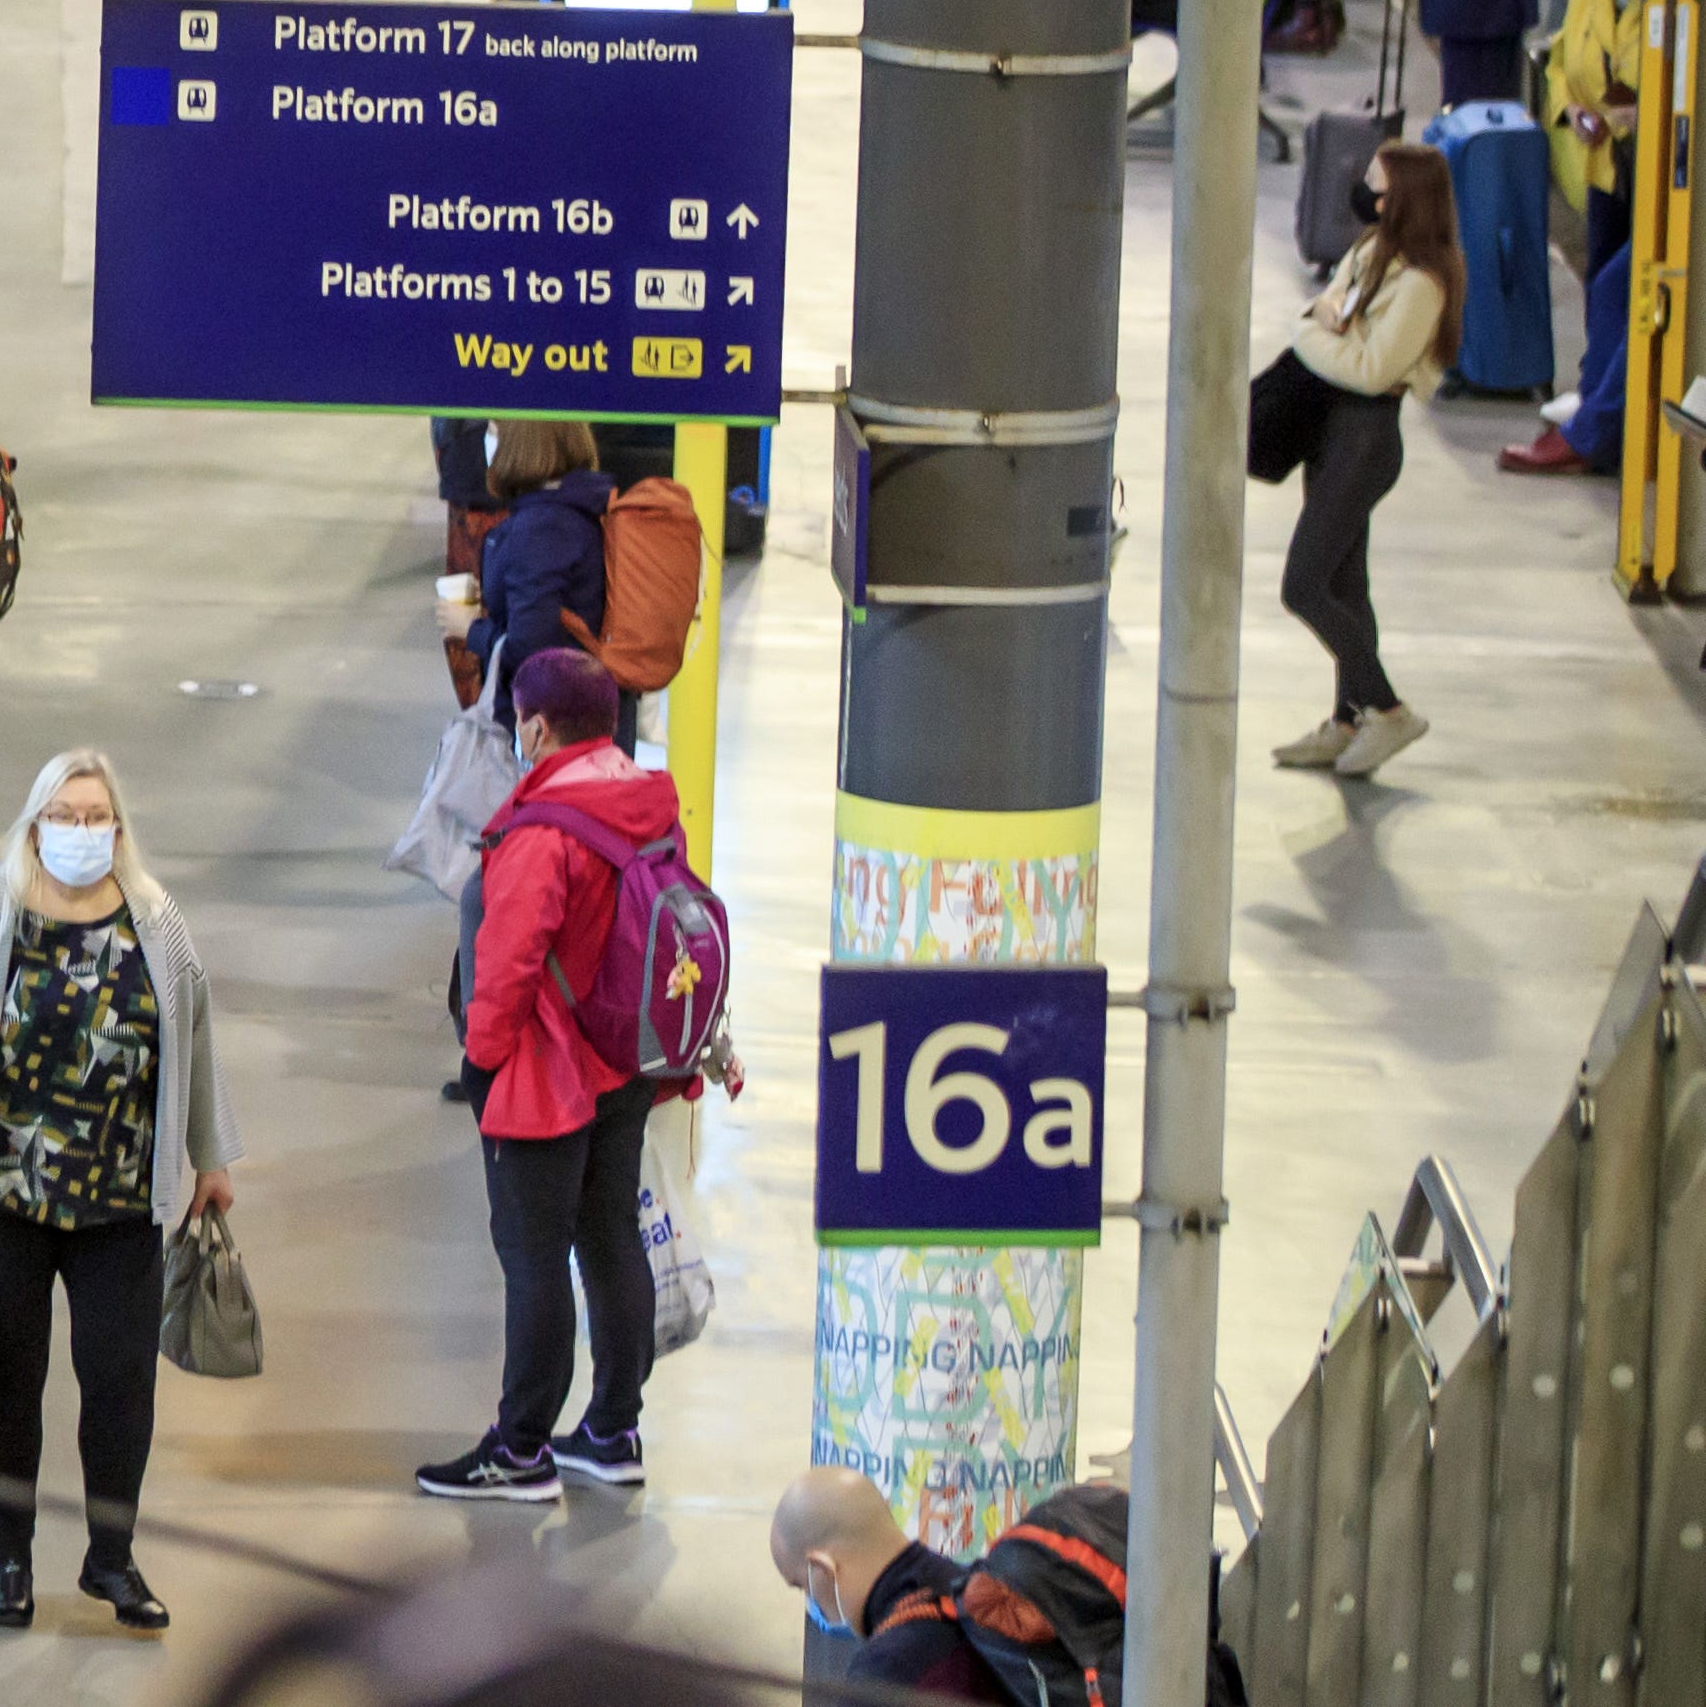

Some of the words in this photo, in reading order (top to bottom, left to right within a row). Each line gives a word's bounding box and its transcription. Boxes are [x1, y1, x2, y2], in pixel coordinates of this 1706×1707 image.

[274, 15, 426, 54] Platform
[438, 20, 475, 55] 17
[485, 33, 535, 57] back
[541, 35, 600, 64] along
[605, 37, 698, 64] platform
[272, 85, 424, 124] Platform
[439, 90, 498, 127] 16a
[388, 194, 540, 232] Platform
[551, 198, 614, 235] 16b
[321, 262, 492, 301] Platforms
[502, 267, 516, 301] 1
[526, 271, 563, 303] to
[574, 269, 611, 304] 15
[454, 333, 533, 377] Way
[544, 340, 608, 372] out
[829, 1021, 1093, 1175] 16a
[820, 1321, 957, 1373] NAPPING
[970, 1331, 1078, 1373] NAPPIN
[960, 1452, 1067, 1492] NAPPIN
